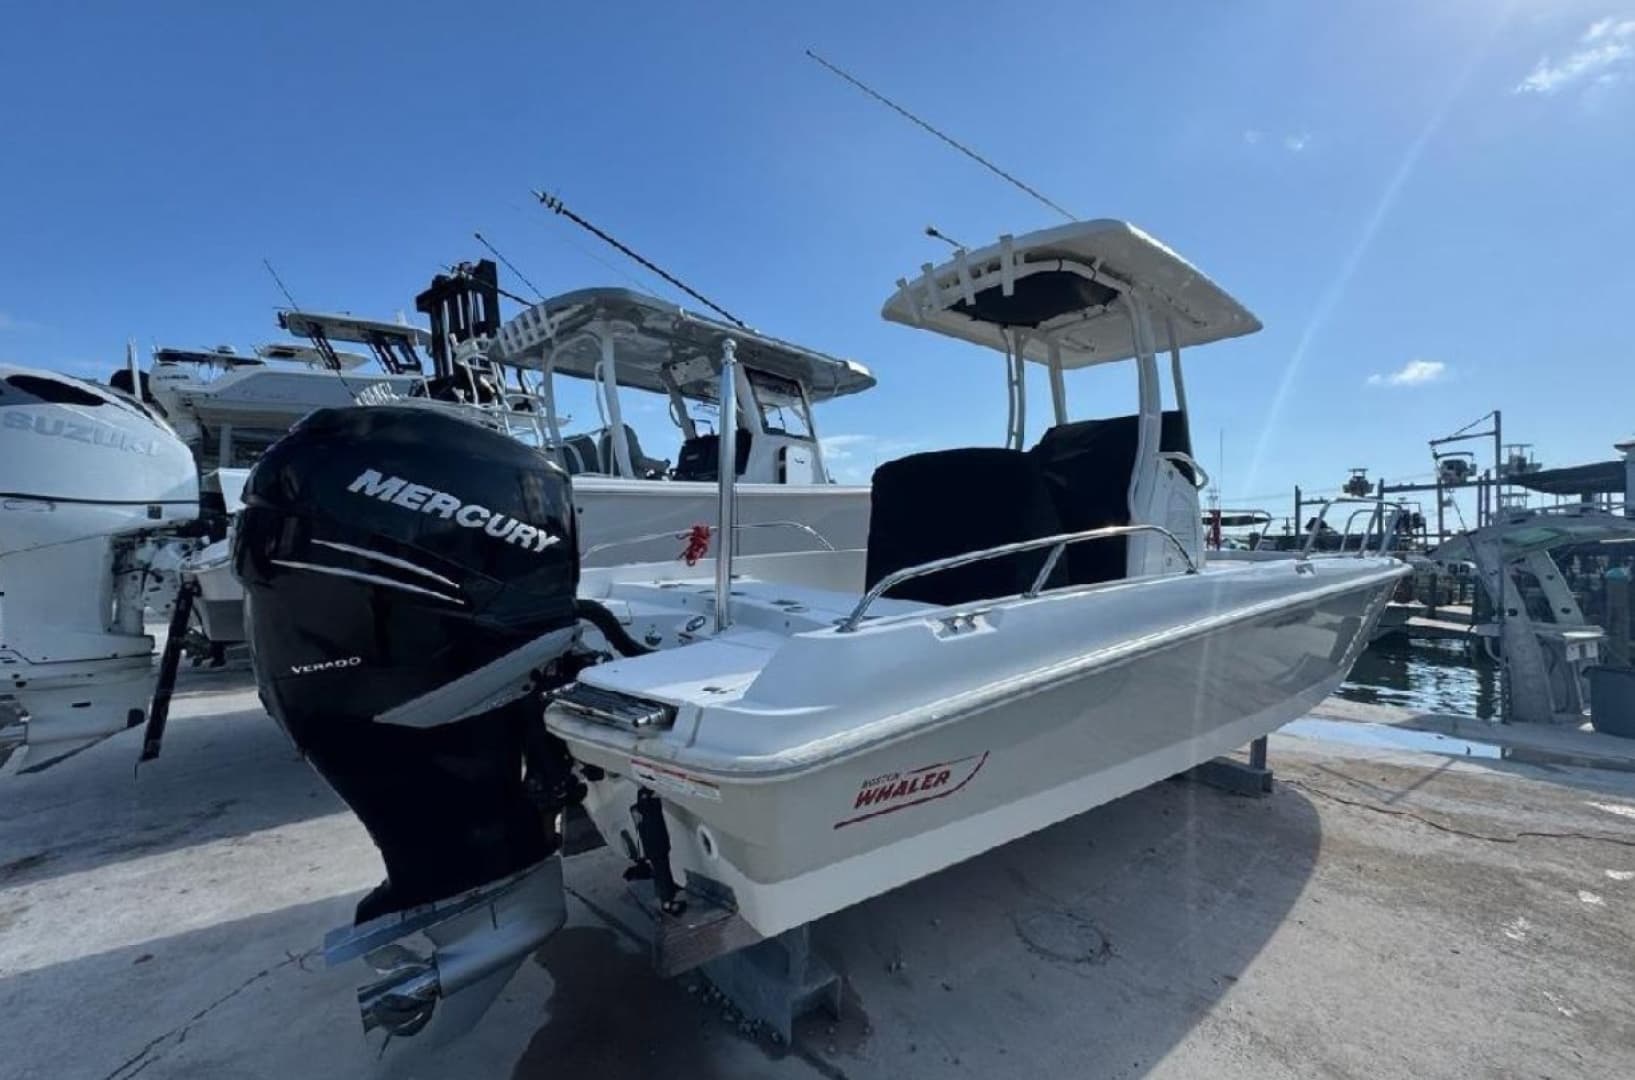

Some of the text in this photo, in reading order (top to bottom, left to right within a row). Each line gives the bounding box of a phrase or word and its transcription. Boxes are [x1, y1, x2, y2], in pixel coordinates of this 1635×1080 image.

[3, 411, 160, 457] SUZUKI
[347, 468, 560, 552] MERCURY
[854, 769, 951, 809] WHALER
